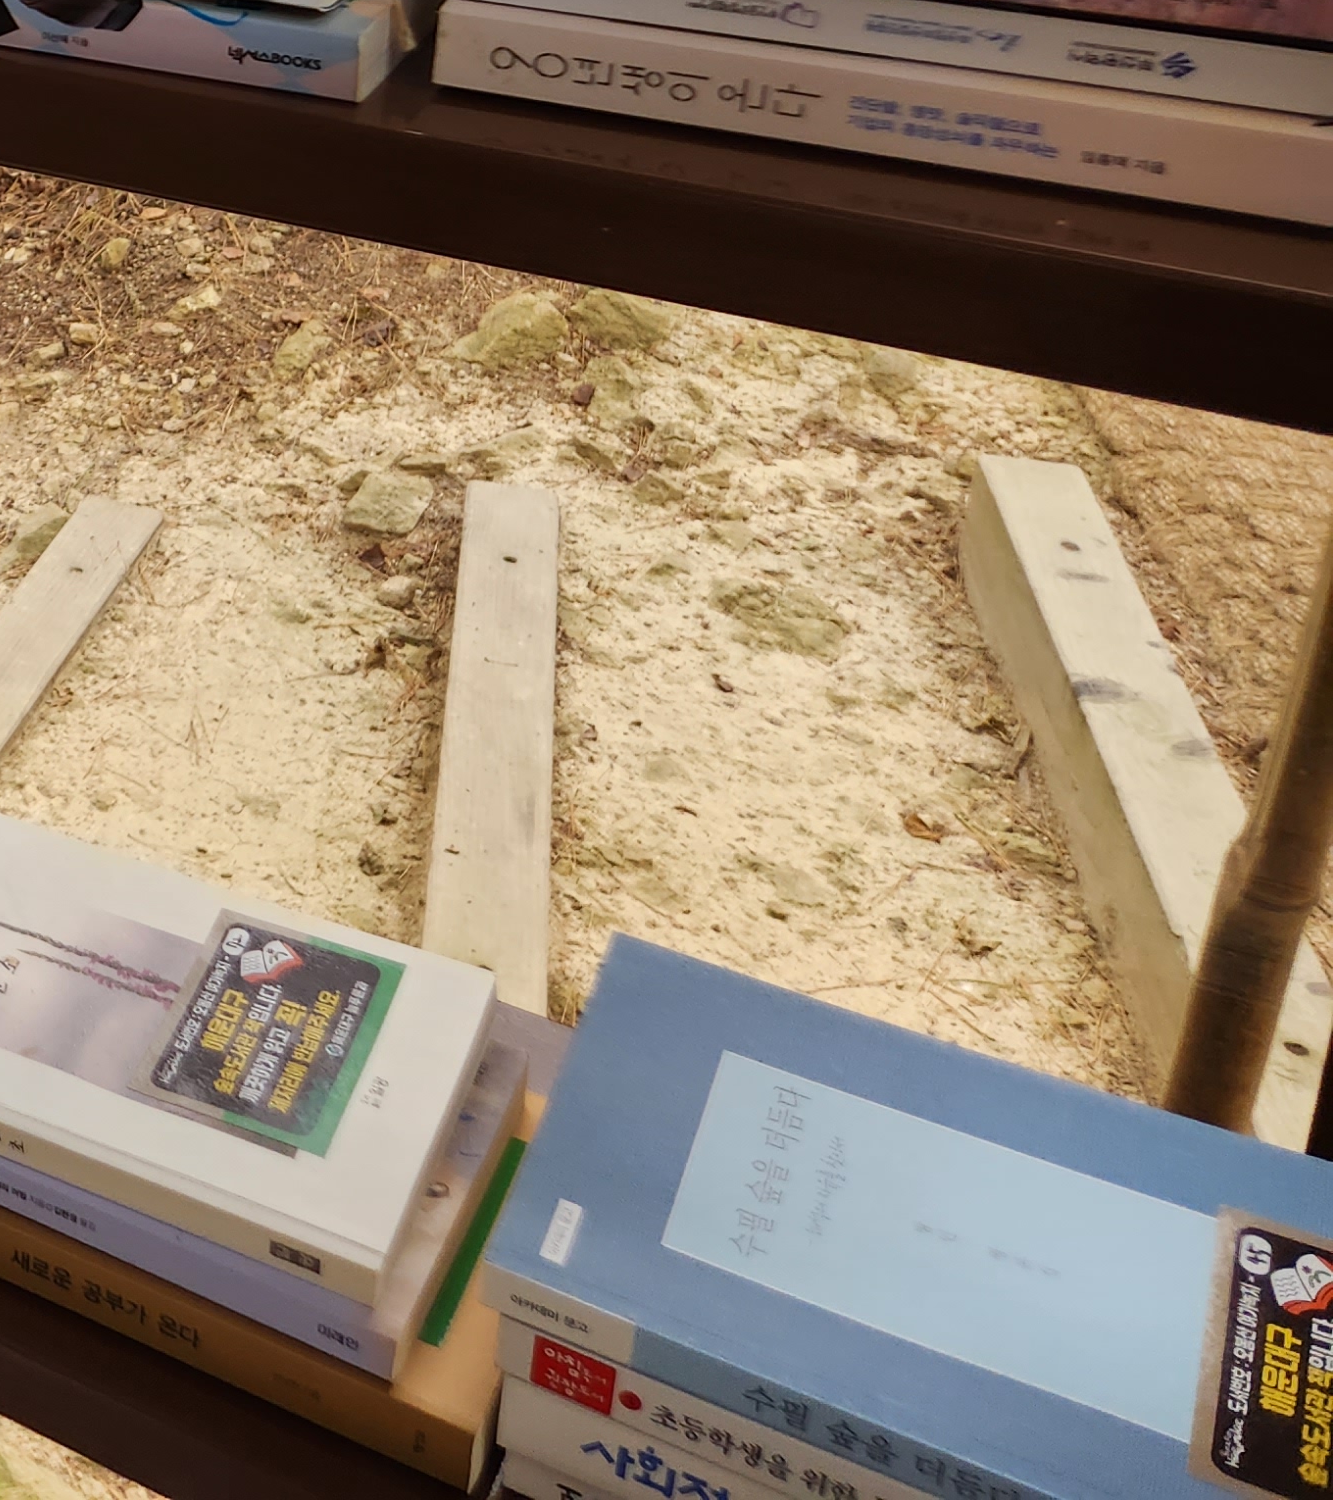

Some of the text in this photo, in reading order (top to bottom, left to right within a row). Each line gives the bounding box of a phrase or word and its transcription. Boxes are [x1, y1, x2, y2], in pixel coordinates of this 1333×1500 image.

[488, 43, 821, 121] 90년생이 온다
[200, 988, 251, 1052] 해운대구
[214, 981, 284, 1095] 숲속도서관 책입니다.
[241, 1001, 309, 1104] 깨끗하게 읽고 꼭!
[268, 986, 342, 1114] 제자리에 반납해주세요.
[728, 1085, 811, 1257] 수필 숲을 더듬다
[12, 1246, 200, 1347] 새로운 공부가 온다
[317, 1324, 359, 1351] 미래인
[510, 1292, 560, 1325] 아카데미
[1228, 1282, 1261, 1415] 도서번호 오봉산 여가녹지
[1259, 1323, 1302, 1417] 해운대구
[649, 1404, 857, 1500] 초등학생을 위한
[742, 1384, 806, 1431] 수필
[826, 1416, 900, 1466] 숲을
